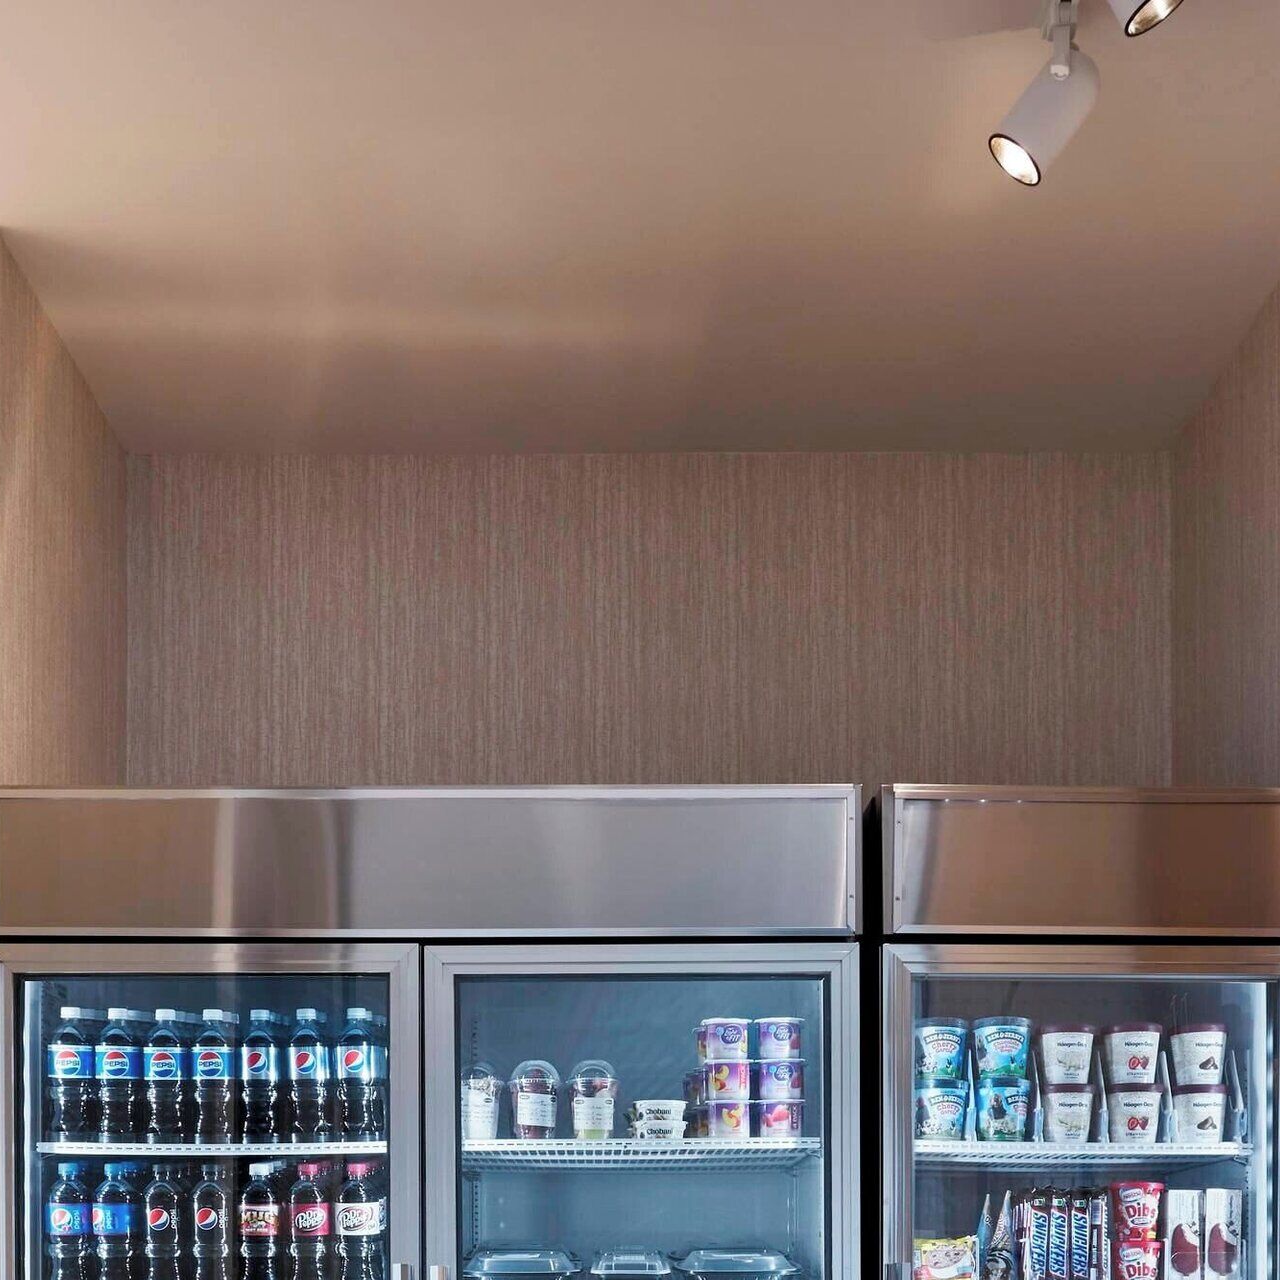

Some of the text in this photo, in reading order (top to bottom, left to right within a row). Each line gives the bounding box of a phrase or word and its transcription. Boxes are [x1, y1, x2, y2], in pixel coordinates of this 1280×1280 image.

[104, 1060, 129, 1068] PEPSI
[151, 1061, 175, 1069] PEPSI
[198, 1060, 221, 1068] PEPSI
[646, 1127, 673, 1136] Chobani
[1125, 1201, 1156, 1219] Dibs
[1031, 1211, 1048, 1277] SNICKERS
[1049, 1211, 1067, 1277] SNICKERS
[1072, 1212, 1088, 1278] SNICKERS
[1125, 1260, 1157, 1278] Dibs
